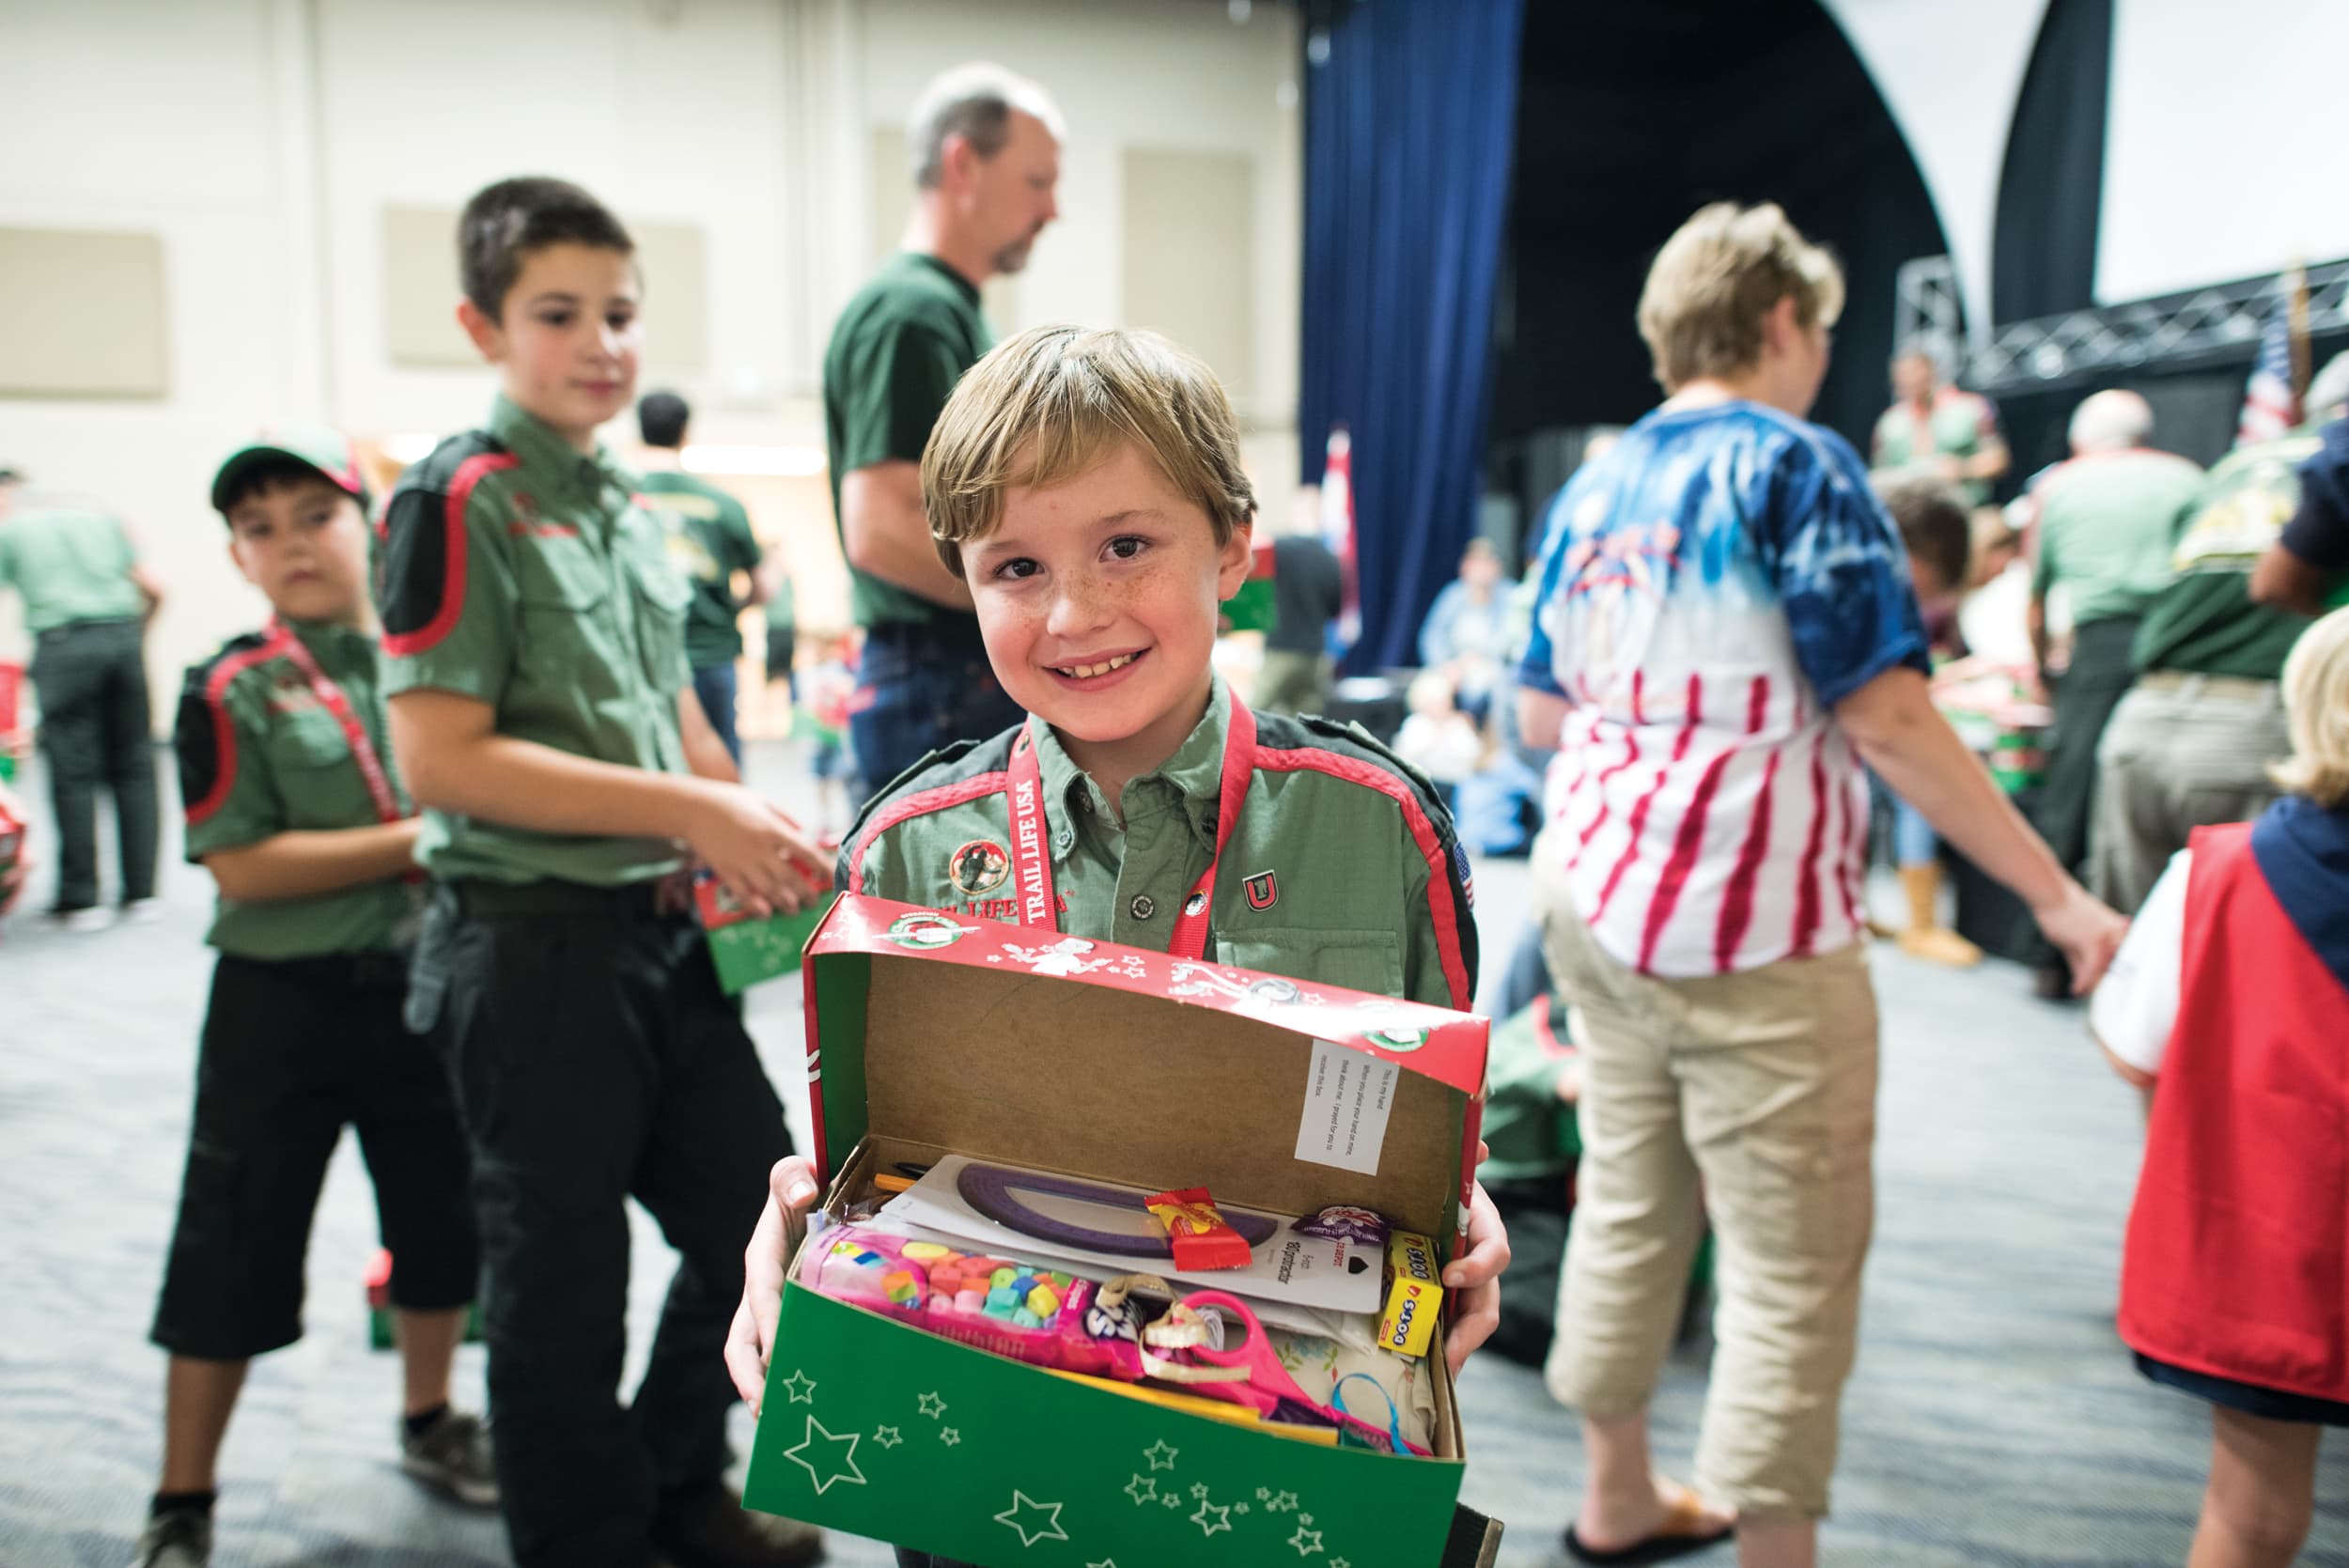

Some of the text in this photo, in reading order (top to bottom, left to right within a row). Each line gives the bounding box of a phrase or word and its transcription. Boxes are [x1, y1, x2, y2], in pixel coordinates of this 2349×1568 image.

[1016, 779, 1046, 924] TRAIL LIFE USA
[967, 898, 1018, 919] LIFE
[1377, 1095, 1387, 1110] hand
[1330, 1106, 1340, 1125] prayed
[1330, 1125, 1338, 1134] for
[1350, 1119, 1360, 1134] hand
[1407, 1247, 1430, 1280] DOTS
[1392, 1299, 1416, 1346] DOTS
